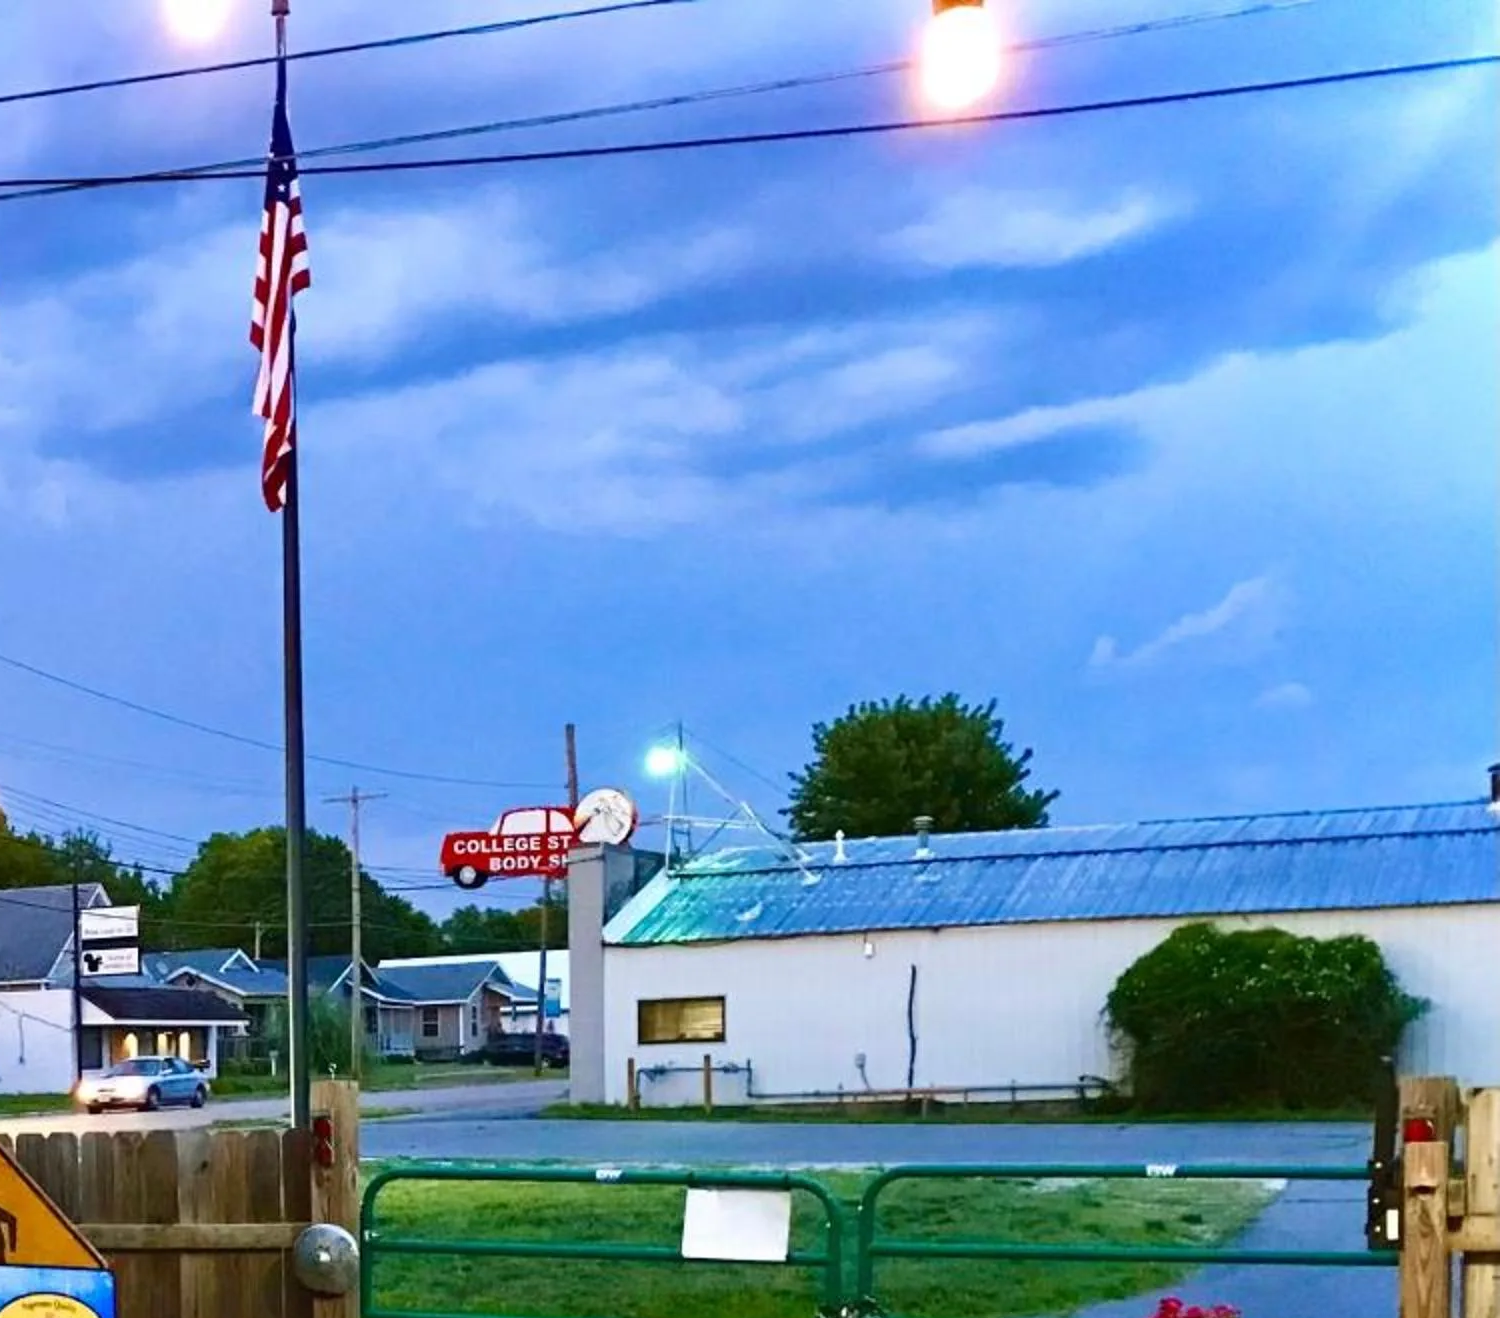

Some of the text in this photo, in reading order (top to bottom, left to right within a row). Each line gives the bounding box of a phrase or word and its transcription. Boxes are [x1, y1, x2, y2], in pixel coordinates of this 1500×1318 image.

[453, 835, 572, 854] COLLEGE ST
[489, 855, 542, 872] BODY
